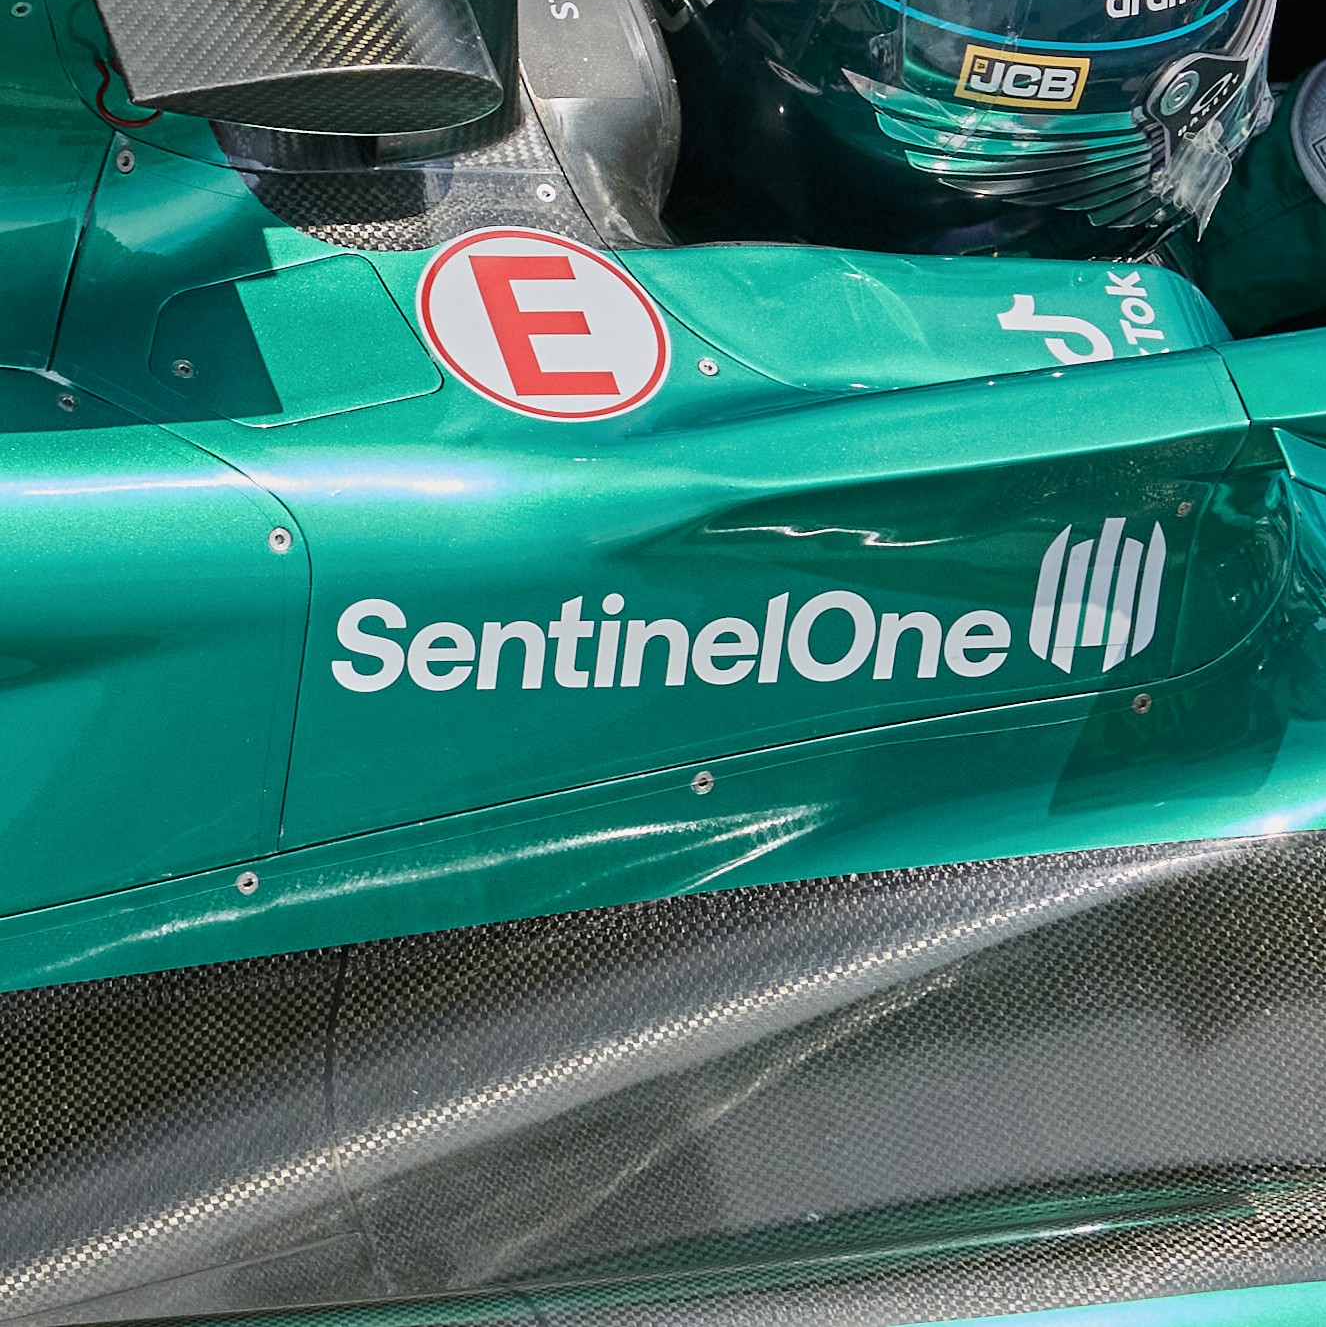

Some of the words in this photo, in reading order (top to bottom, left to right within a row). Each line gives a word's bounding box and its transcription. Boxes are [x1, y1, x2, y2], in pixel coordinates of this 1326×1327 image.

[969, 64, 1077, 100] JCB
[468, 254, 621, 397] E
[330, 590, 1009, 694] SentinelOne
